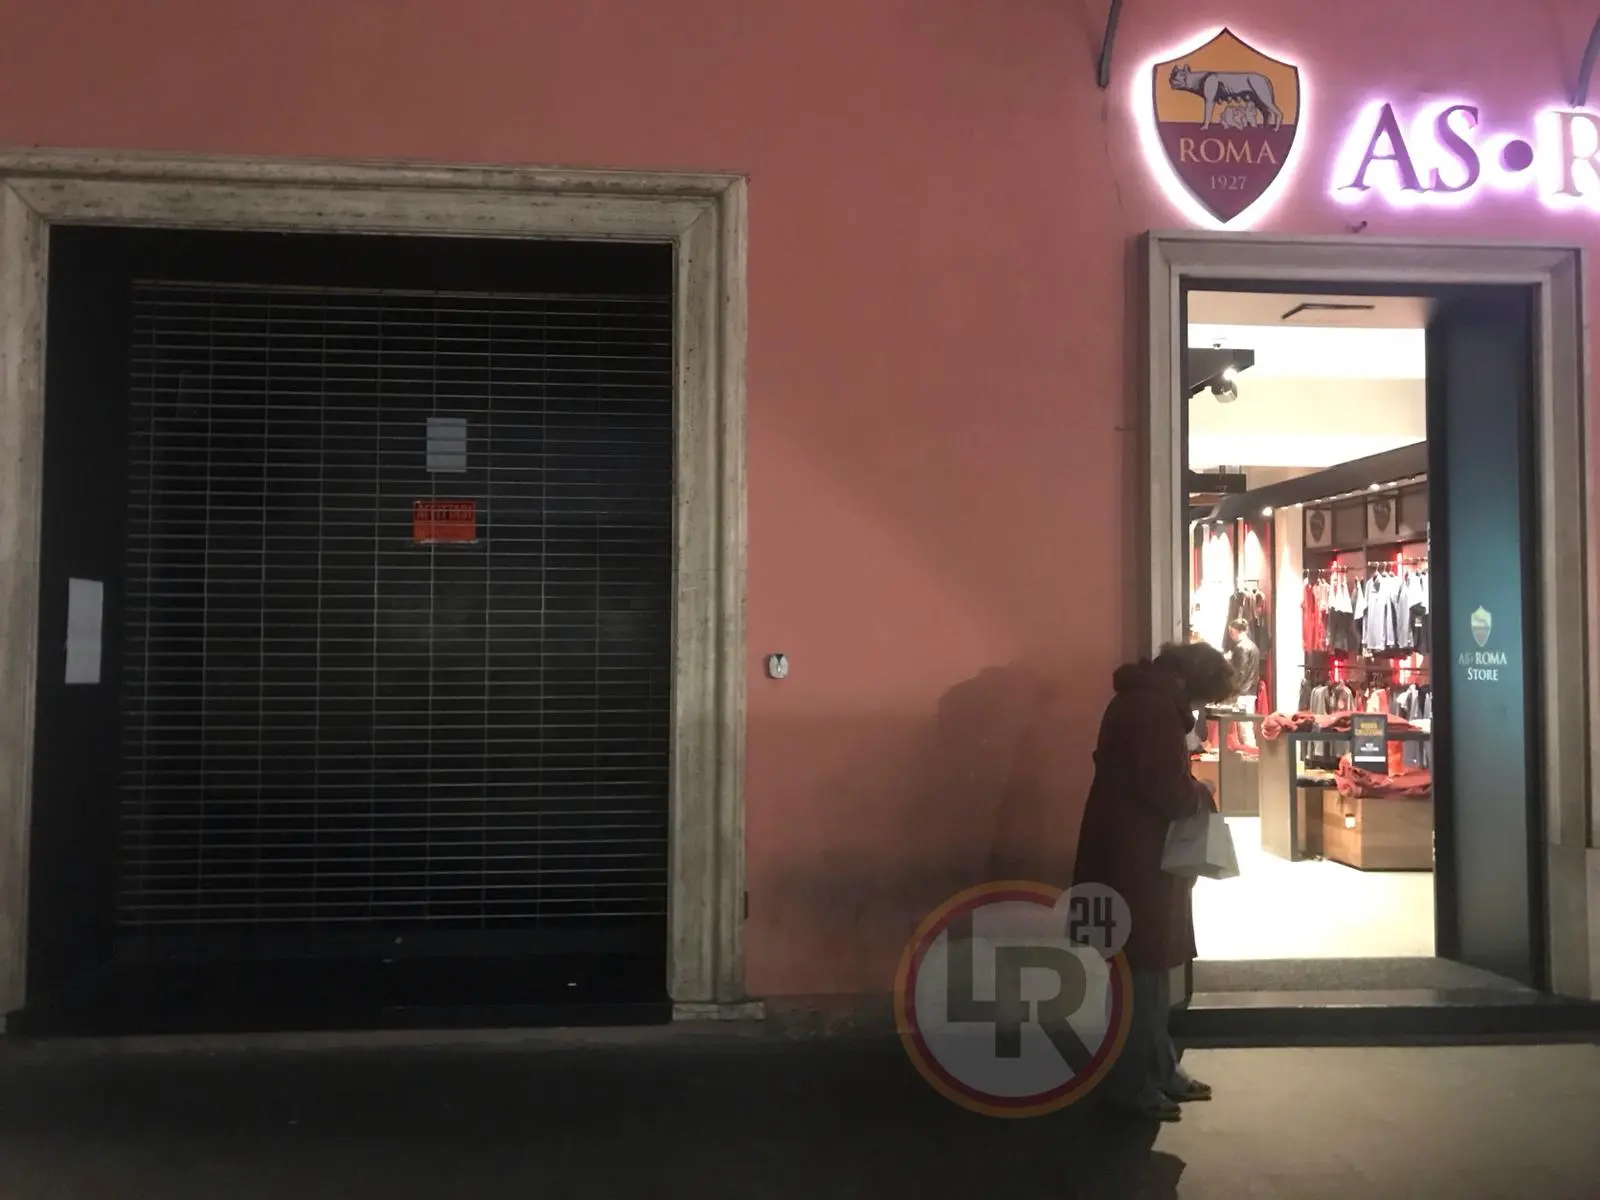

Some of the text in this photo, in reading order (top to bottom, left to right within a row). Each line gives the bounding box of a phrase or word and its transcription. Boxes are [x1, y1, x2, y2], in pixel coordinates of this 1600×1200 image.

[1179, 137, 1278, 164] ROMA
[1210, 175, 1247, 191] 1927
[1475, 652, 1507, 665] ROMA
[1467, 667, 1498, 681] STORE
